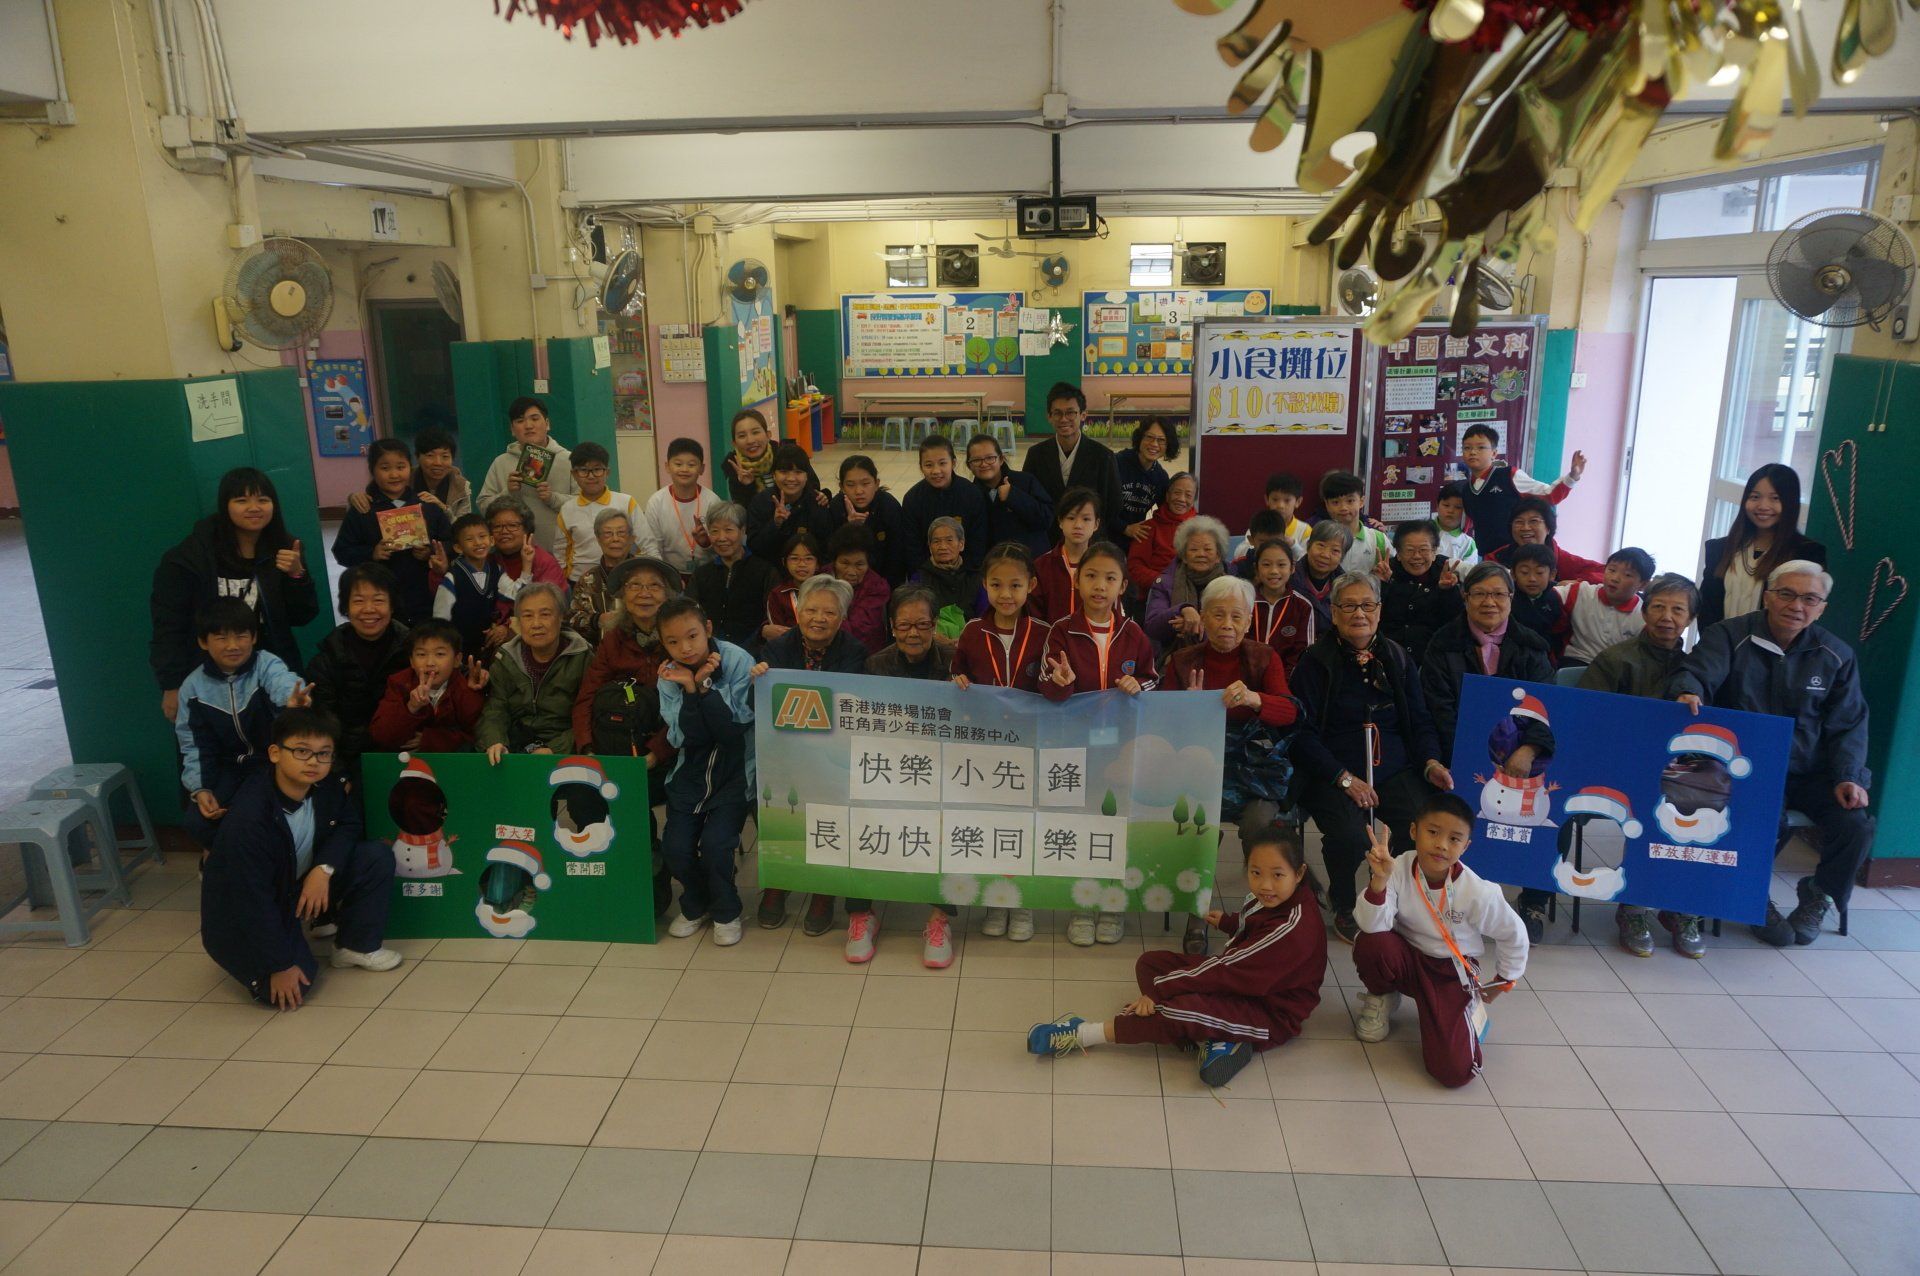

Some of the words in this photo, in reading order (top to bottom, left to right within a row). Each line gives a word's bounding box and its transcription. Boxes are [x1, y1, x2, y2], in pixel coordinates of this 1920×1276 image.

[966, 317, 975, 330] 2
[1169, 311, 1178, 324] 3
[1388, 333, 1529, 361] 中國語文科
[1208, 347, 1348, 380] 小食攤位
[838, 697, 952, 722] 香港遊樂場協會
[838, 715, 1020, 744] 旺角青少年綜合服務中心
[859, 751, 1082, 793] 快樂小先鋒
[496, 825, 535, 841] 常大笑
[809, 818, 1115, 863] 長幼快樂同樂日
[1487, 825, 1531, 843] 常讚賞
[1650, 843, 1737, 866] 常放鬆/運動
[566, 862, 606, 875] 常開朗
[403, 883, 442, 896] 常多謝
